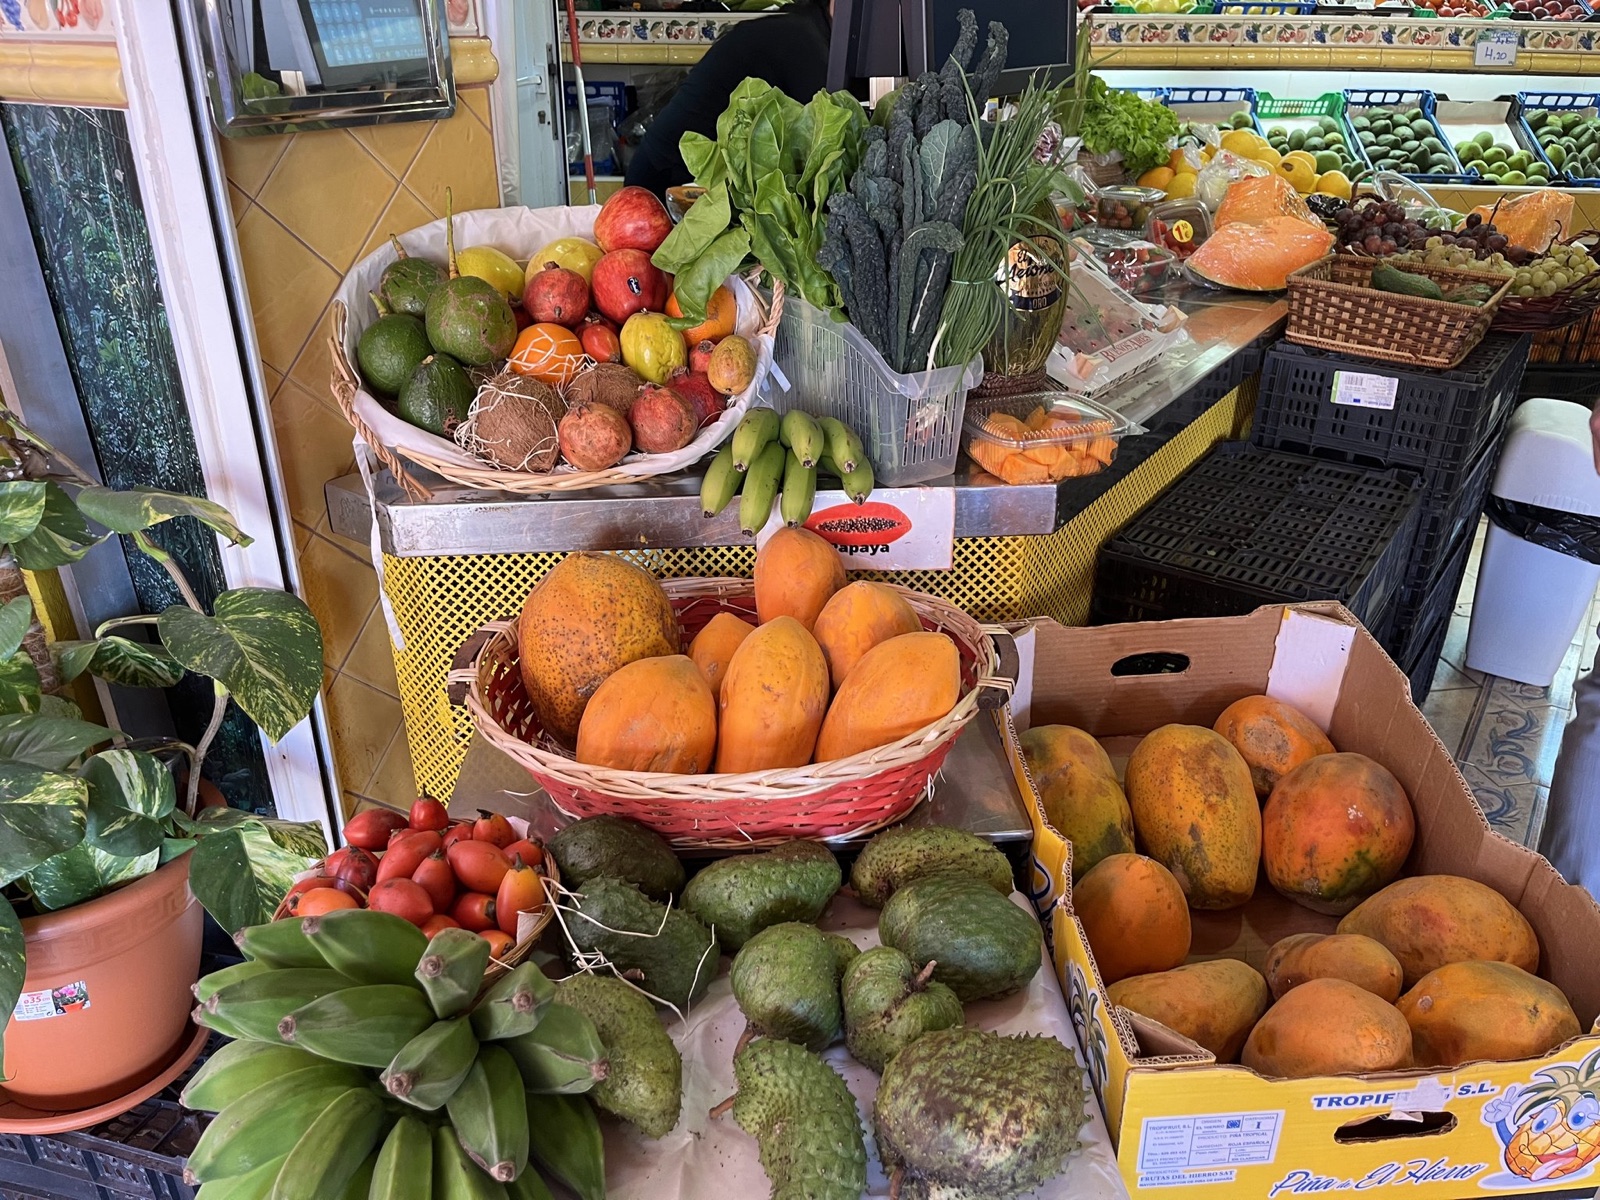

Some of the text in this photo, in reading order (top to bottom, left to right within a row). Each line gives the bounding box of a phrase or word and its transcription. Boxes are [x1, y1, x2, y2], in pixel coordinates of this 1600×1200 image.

[1032, 297, 1047, 309] ORO
[1458, 1083, 1495, 1096] S.L.
[1269, 1171, 1337, 1197] Piña
[1355, 1163, 1400, 1190] El
[1398, 1158, 1486, 1184] Hierro
